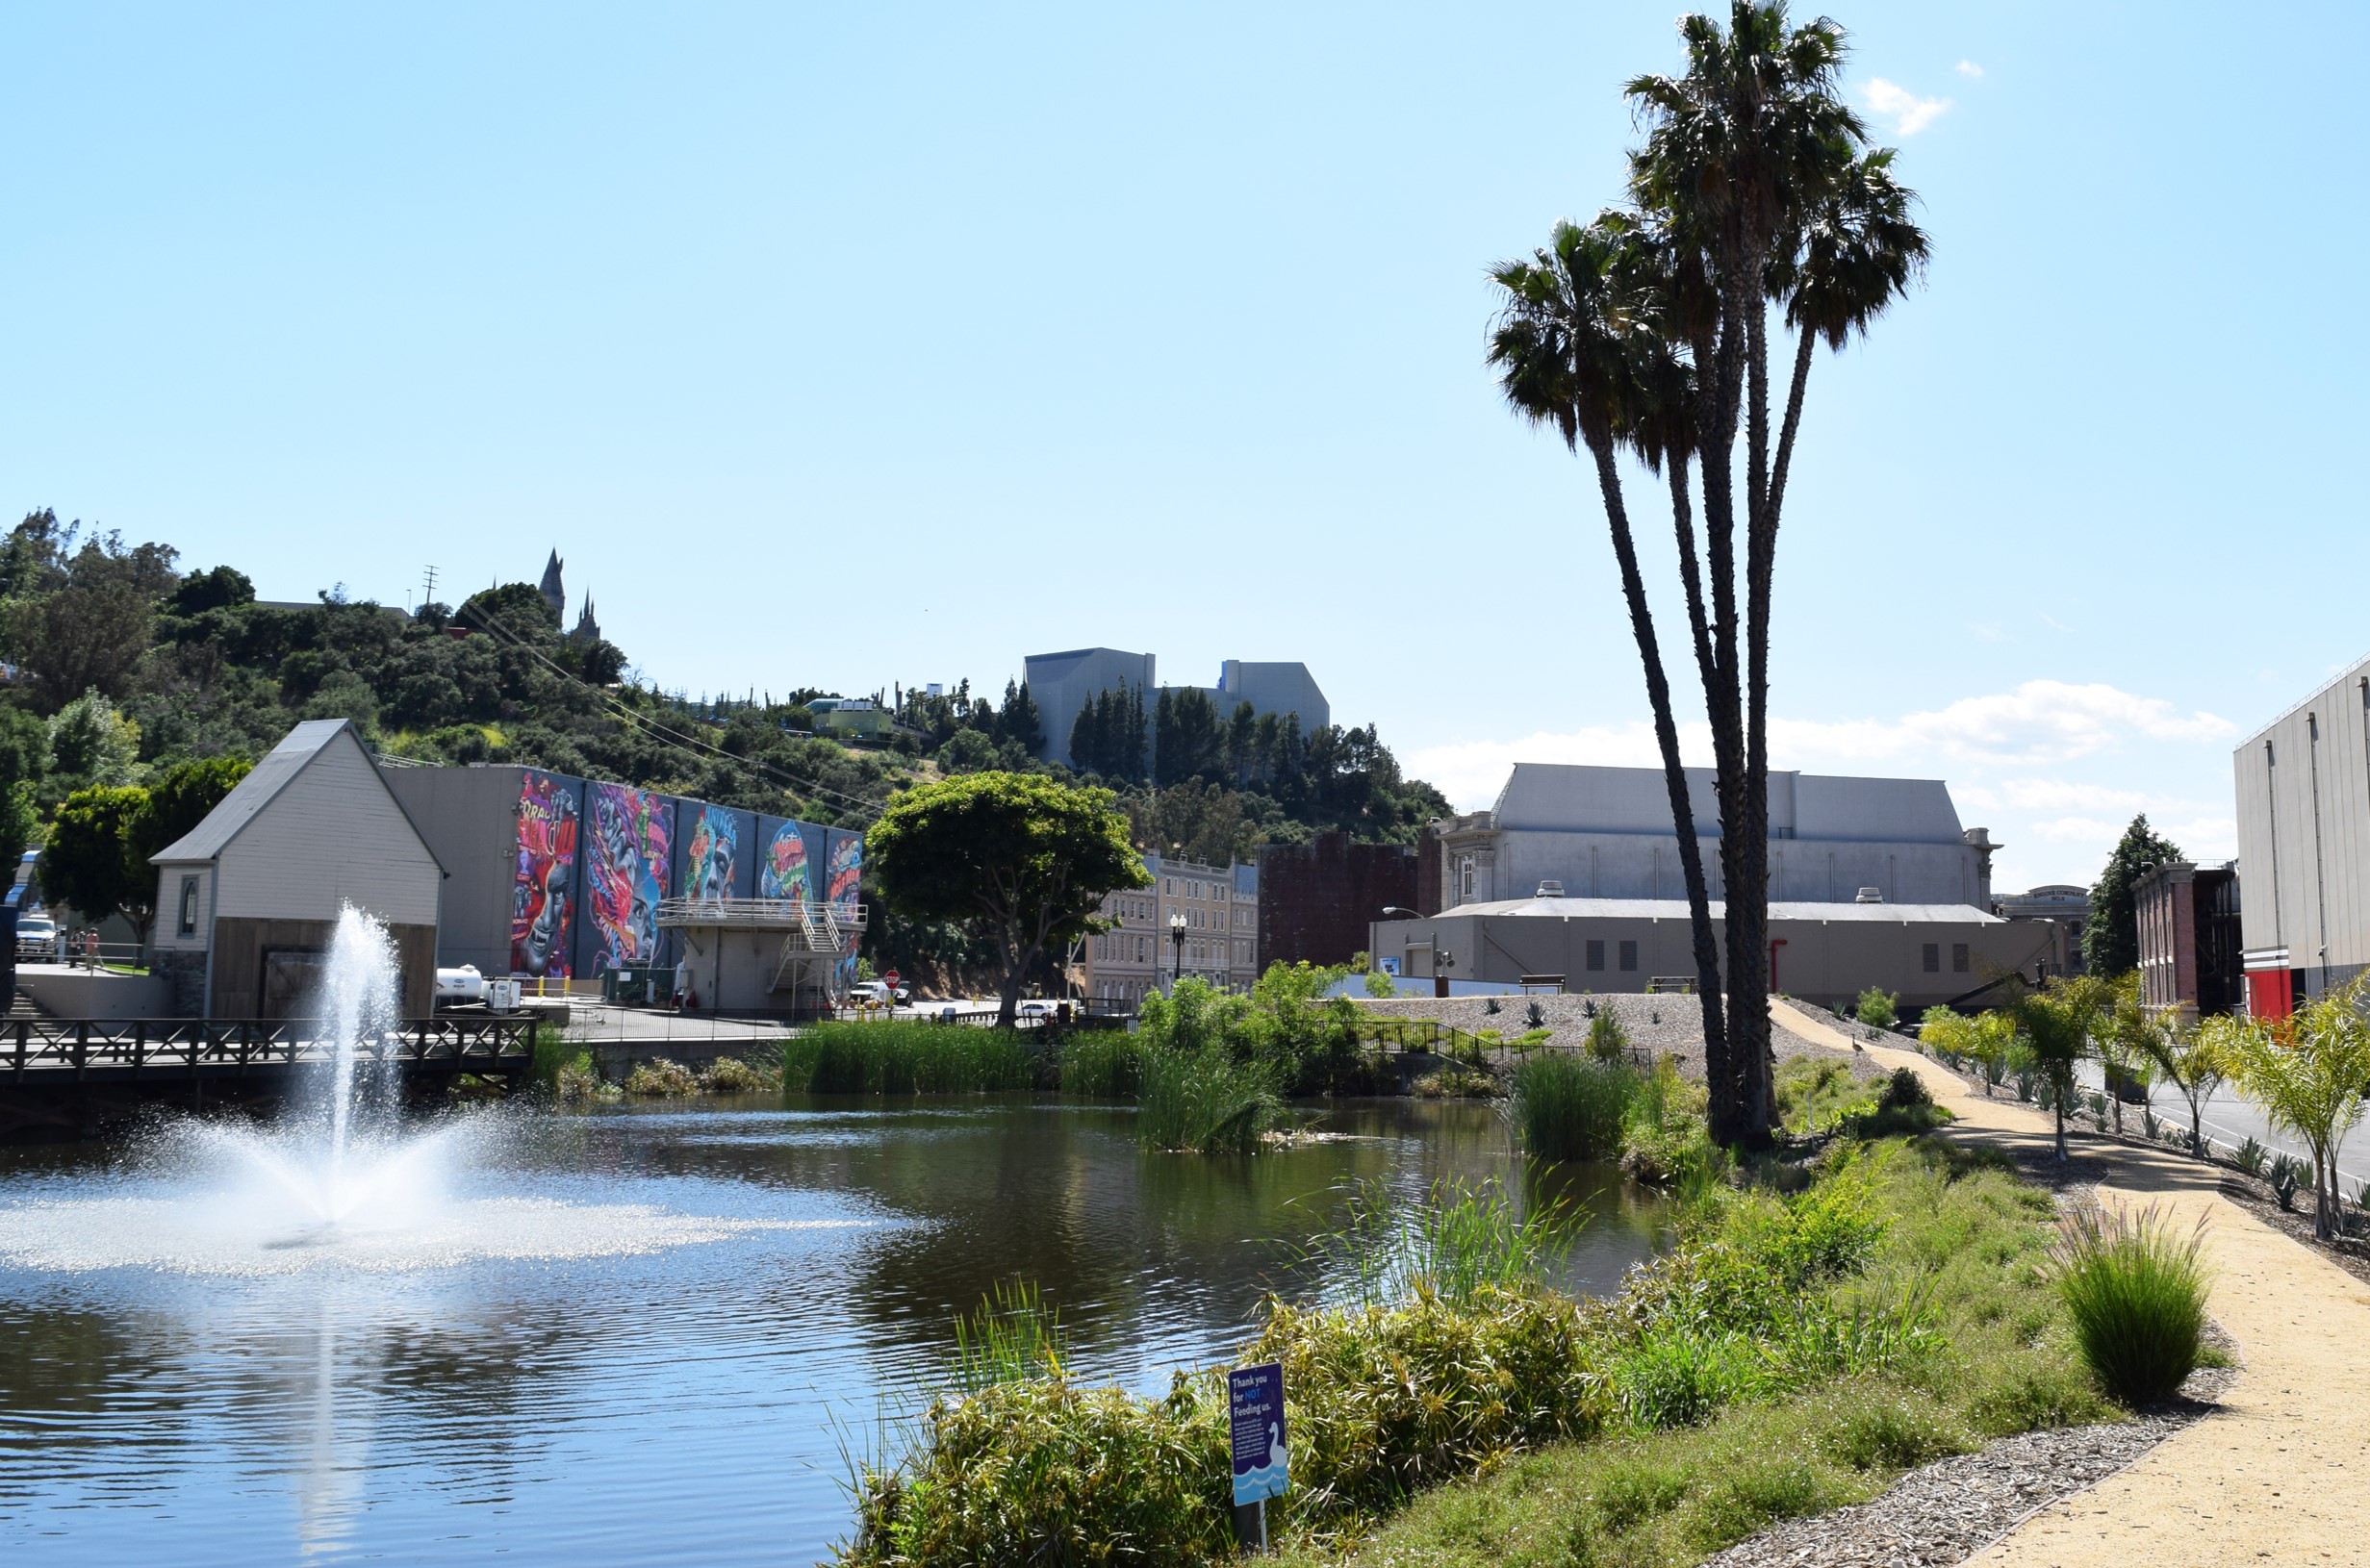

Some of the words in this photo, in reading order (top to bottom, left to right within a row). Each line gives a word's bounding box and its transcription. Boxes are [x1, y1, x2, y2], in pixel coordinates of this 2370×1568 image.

[2033, 890, 2055, 898] ENGINE
[2056, 890, 2084, 898] COMPANY
[886, 975, 900, 984] STOP
[1233, 1375, 1255, 1388] Thank
[1255, 1376, 1267, 1387] you
[1233, 1392, 1244, 1404] for
[1245, 1388, 1261, 1400] NOT
[1234, 1402, 1261, 1418] Feeding
[1261, 1403, 1272, 1411] us.
